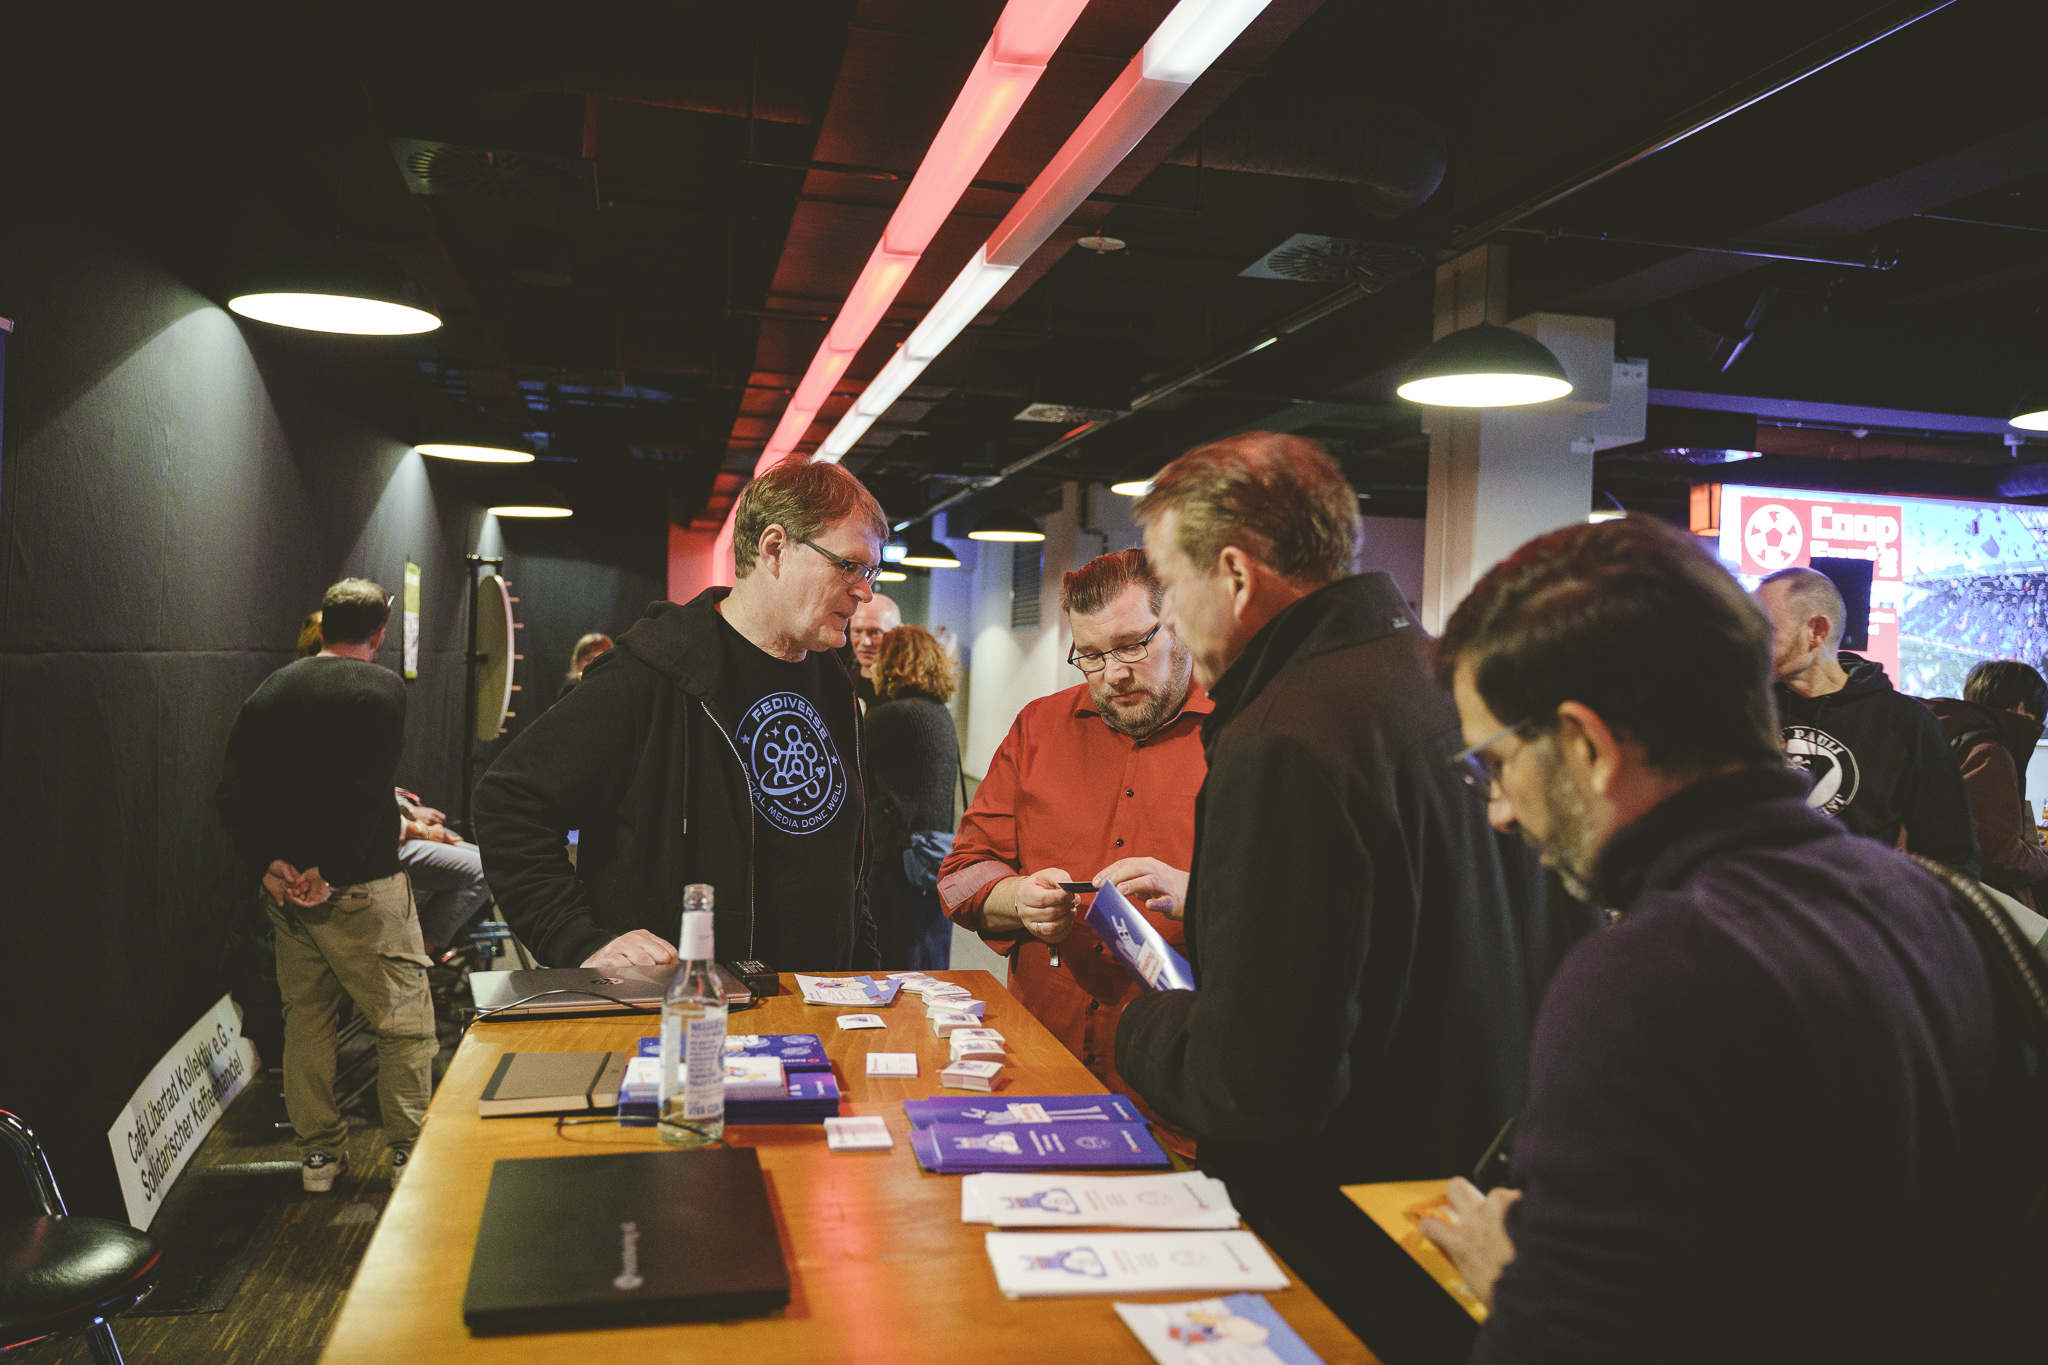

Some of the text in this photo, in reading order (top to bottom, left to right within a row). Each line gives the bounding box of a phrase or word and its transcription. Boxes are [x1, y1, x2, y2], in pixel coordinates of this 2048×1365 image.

[1811, 505, 1899, 549] Coop
[751, 696, 828, 740] FEDIVERSE
[1793, 729, 1845, 755] PAULI
[767, 805, 799, 828] MEDIA
[826, 782, 843, 811] WELL
[128, 1115, 148, 1164] Café
[144, 1074, 180, 1138] Libertad
[175, 1042, 214, 1095] Kollektiv
[212, 1023, 231, 1055] e.G.
[141, 1049, 245, 1202] Solidarischer Kaffeehandel
